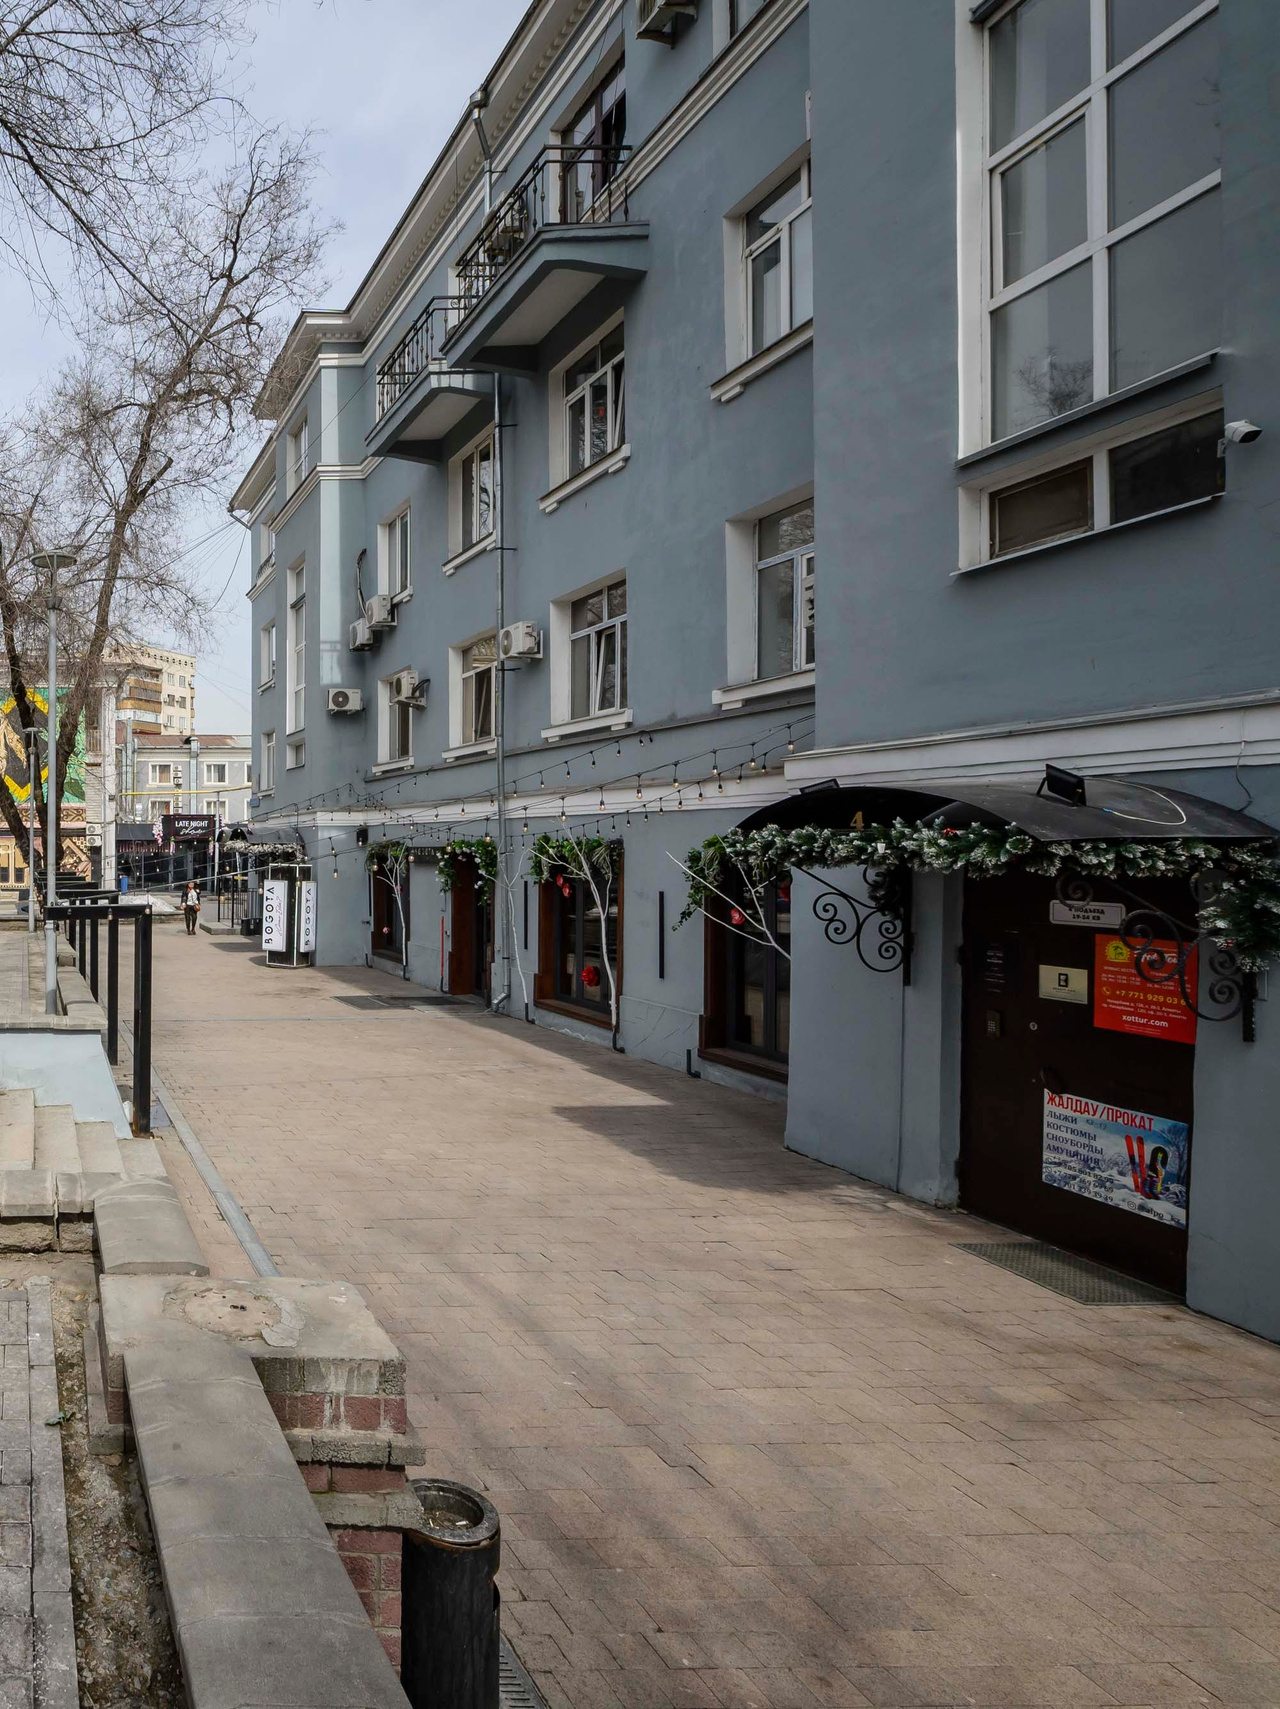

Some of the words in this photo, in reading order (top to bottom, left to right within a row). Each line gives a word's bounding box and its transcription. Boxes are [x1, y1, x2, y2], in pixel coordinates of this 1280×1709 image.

[850, 811, 864, 830] 4
[265, 887, 275, 944] BOGOTA
[1129, 991, 1144, 999] 771
[1147, 993, 1164, 1002] 929
[1122, 1014, 1168, 1027] xottur.com
[1046, 1110, 1078, 1125] ЛЫЖИ
[1047, 1091, 1154, 1132] ЖАЛДАУ/ПРОКАТ
[1046, 1121, 1097, 1142] КОСТЮМЫ
[1046, 1132, 1104, 1155] СНОУБОРДЫ
[1046, 1144, 1101, 1166] АМУНИЦИЯ
